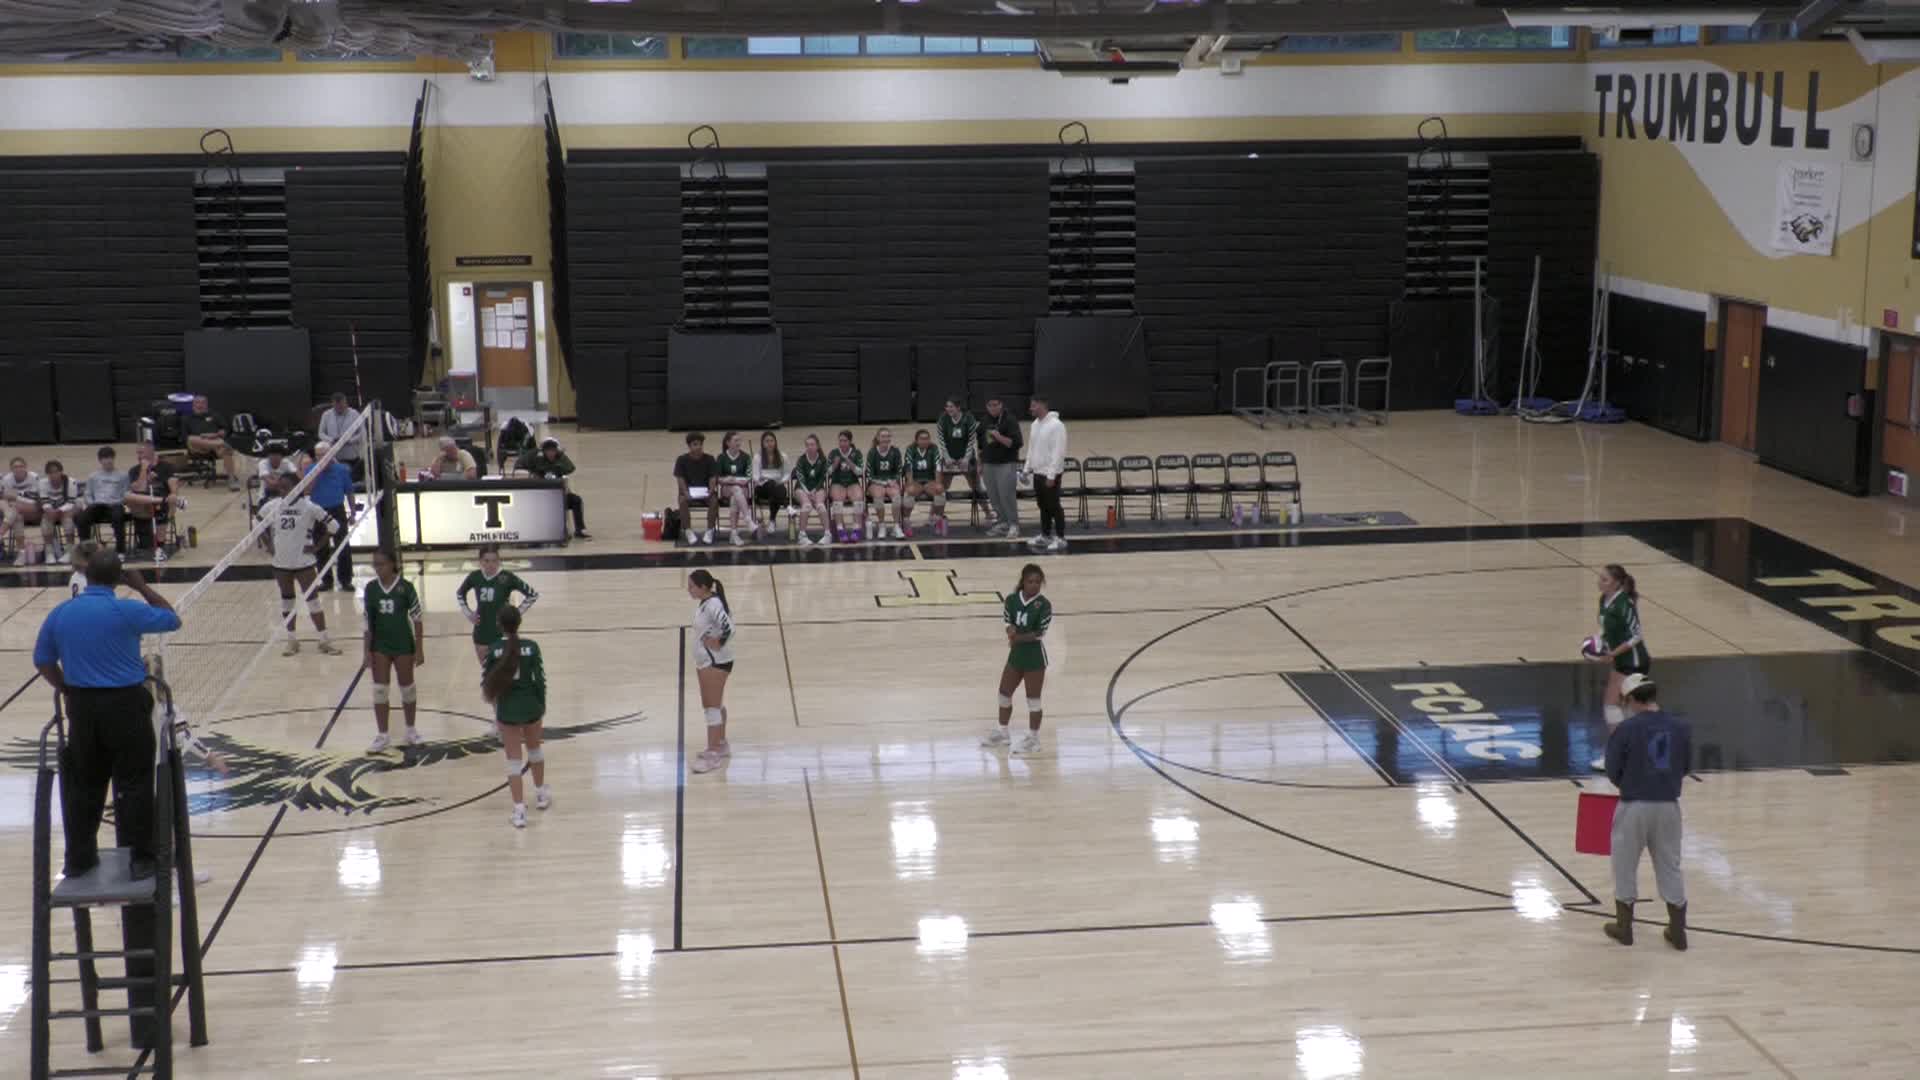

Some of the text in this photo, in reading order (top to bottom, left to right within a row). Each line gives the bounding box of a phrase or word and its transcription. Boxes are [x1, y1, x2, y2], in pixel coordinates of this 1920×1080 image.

[1595, 70, 1830, 149] TRUMBULL
[474, 495, 511, 528] T
[280, 517, 296, 530] 23
[469, 531, 519, 541] ATHLETICS
[379, 599, 395, 615] 33
[1015, 611, 1028, 627] 14
[1390, 682, 1543, 760] FCIAC
